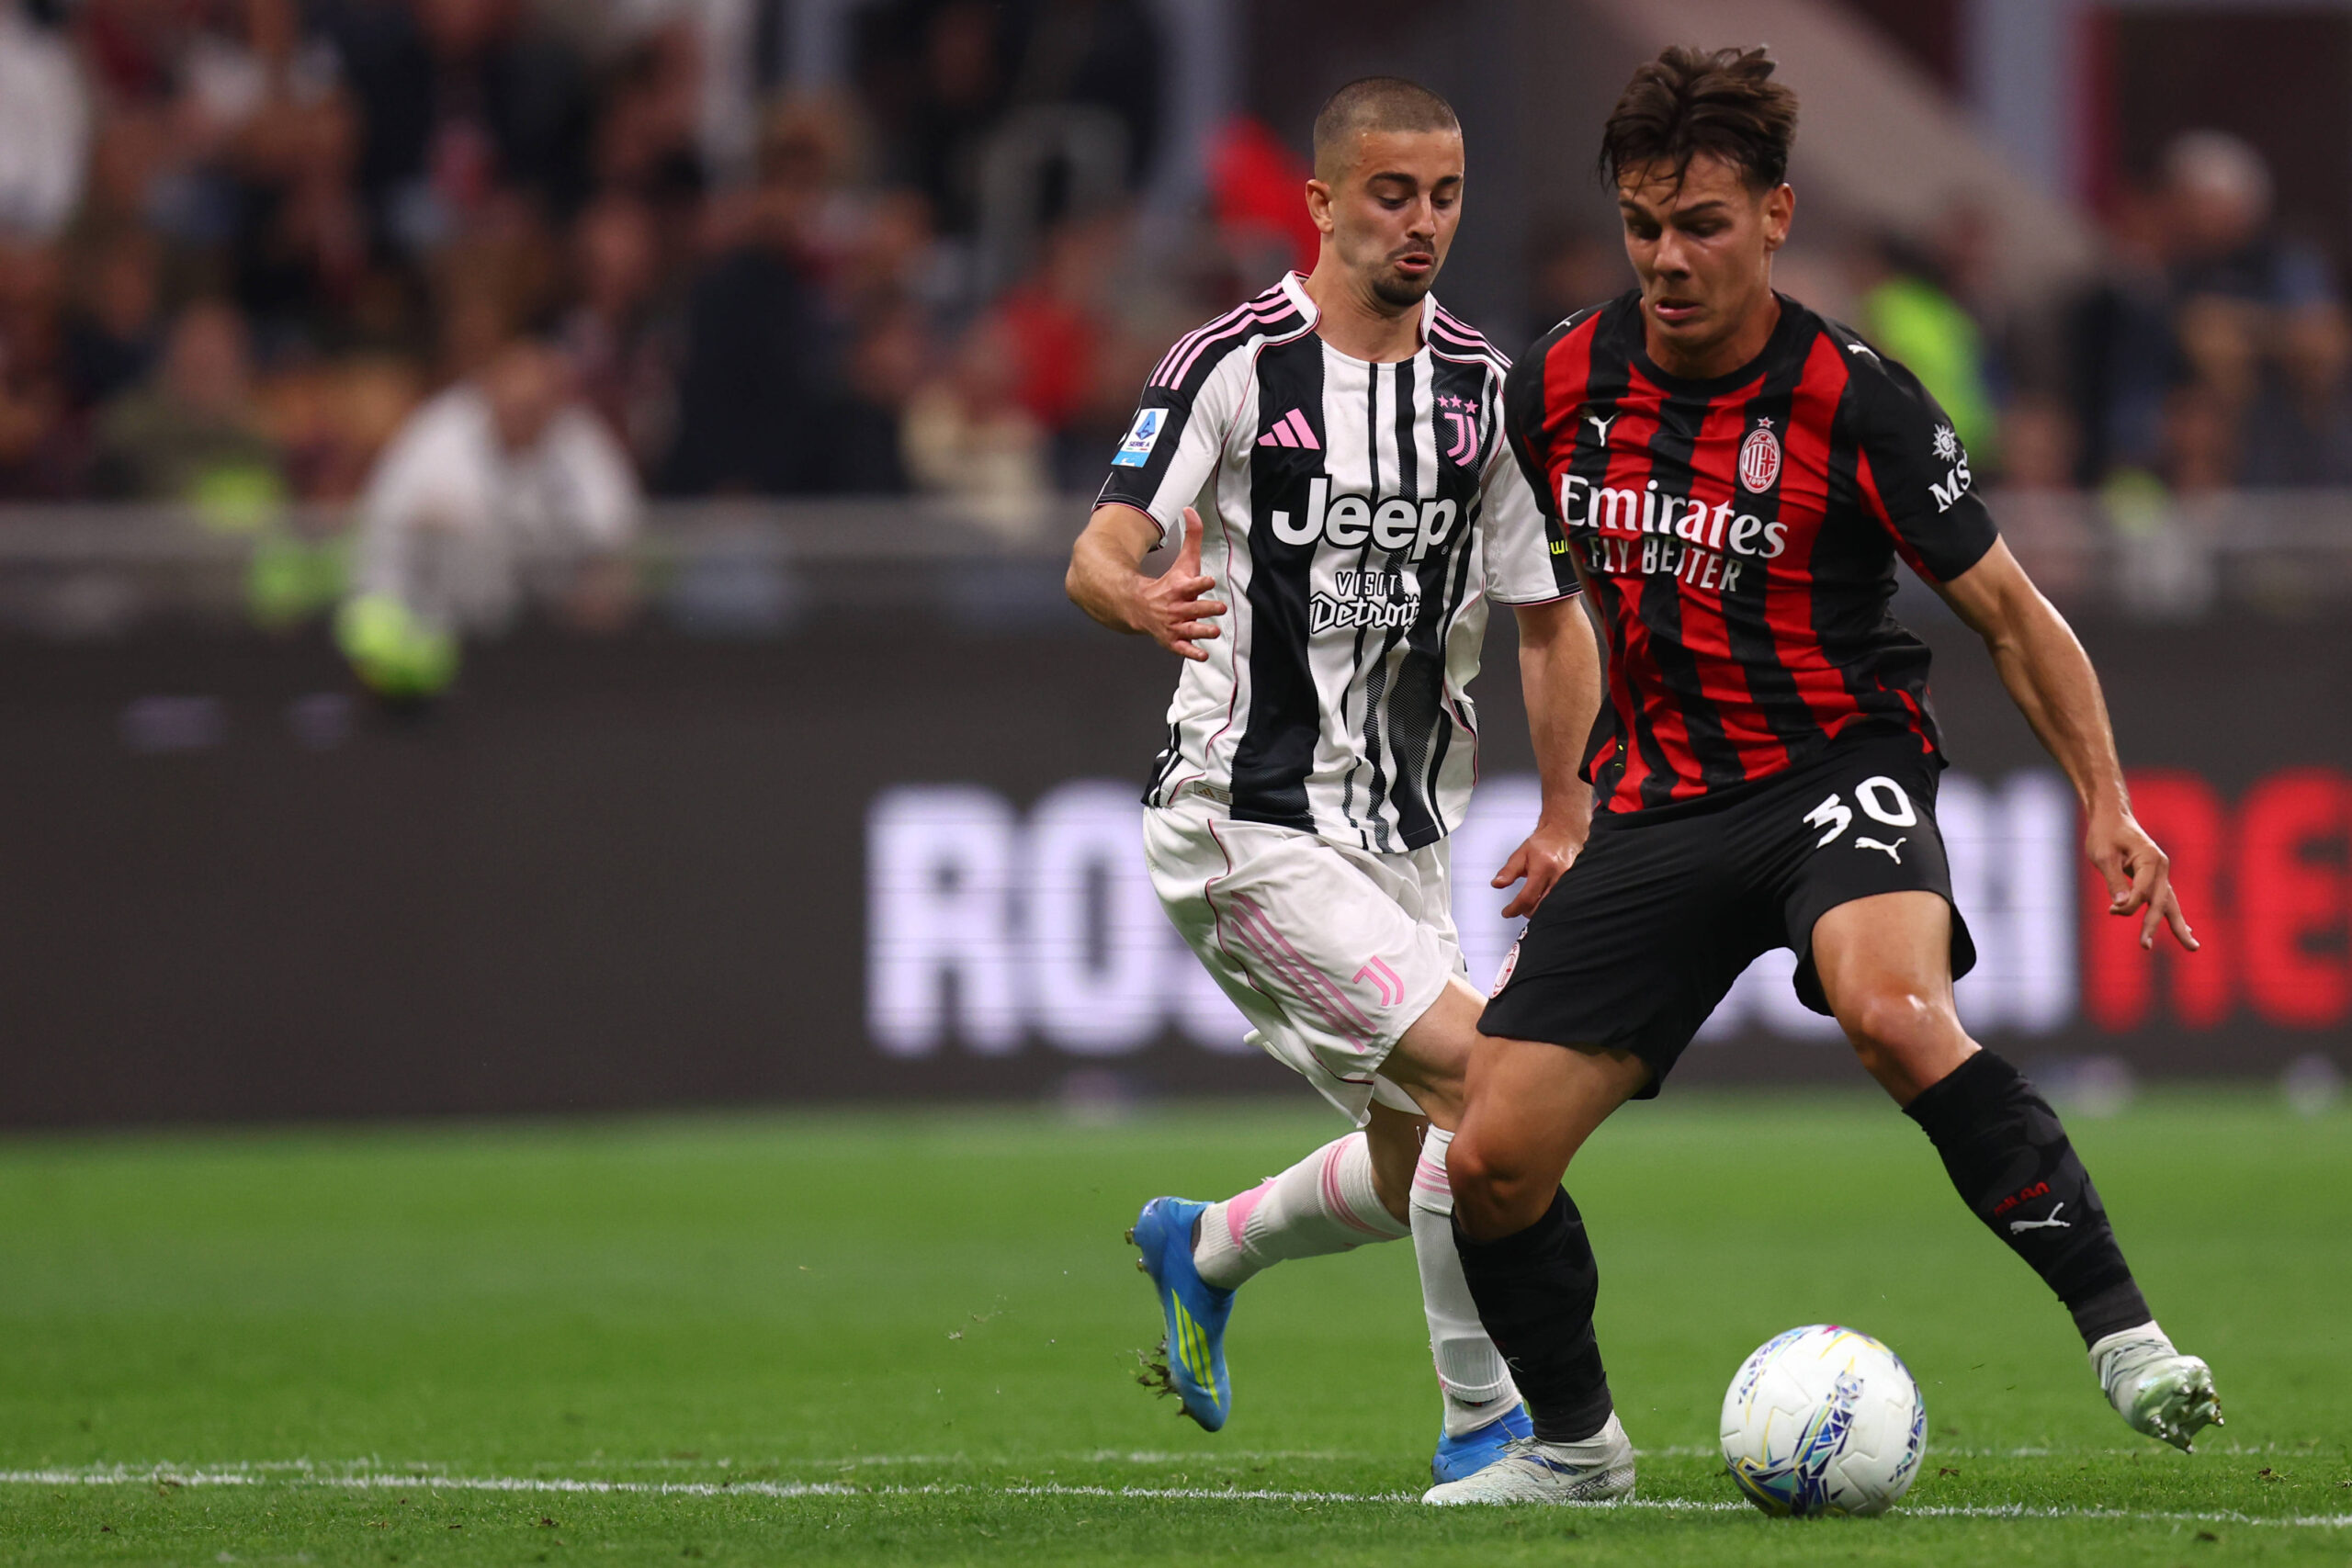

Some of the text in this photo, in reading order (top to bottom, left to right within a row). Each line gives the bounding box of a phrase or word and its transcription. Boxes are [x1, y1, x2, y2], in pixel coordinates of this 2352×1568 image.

[1928, 449, 1972, 513] MS
[1272, 477, 1457, 560] Jeep
[1560, 473, 1789, 558] Emirates
[1336, 571, 1400, 596] VISIT
[1588, 536, 1630, 574] FLY
[1310, 592, 1420, 634] Detroit
[1803, 775, 1917, 849] 30
